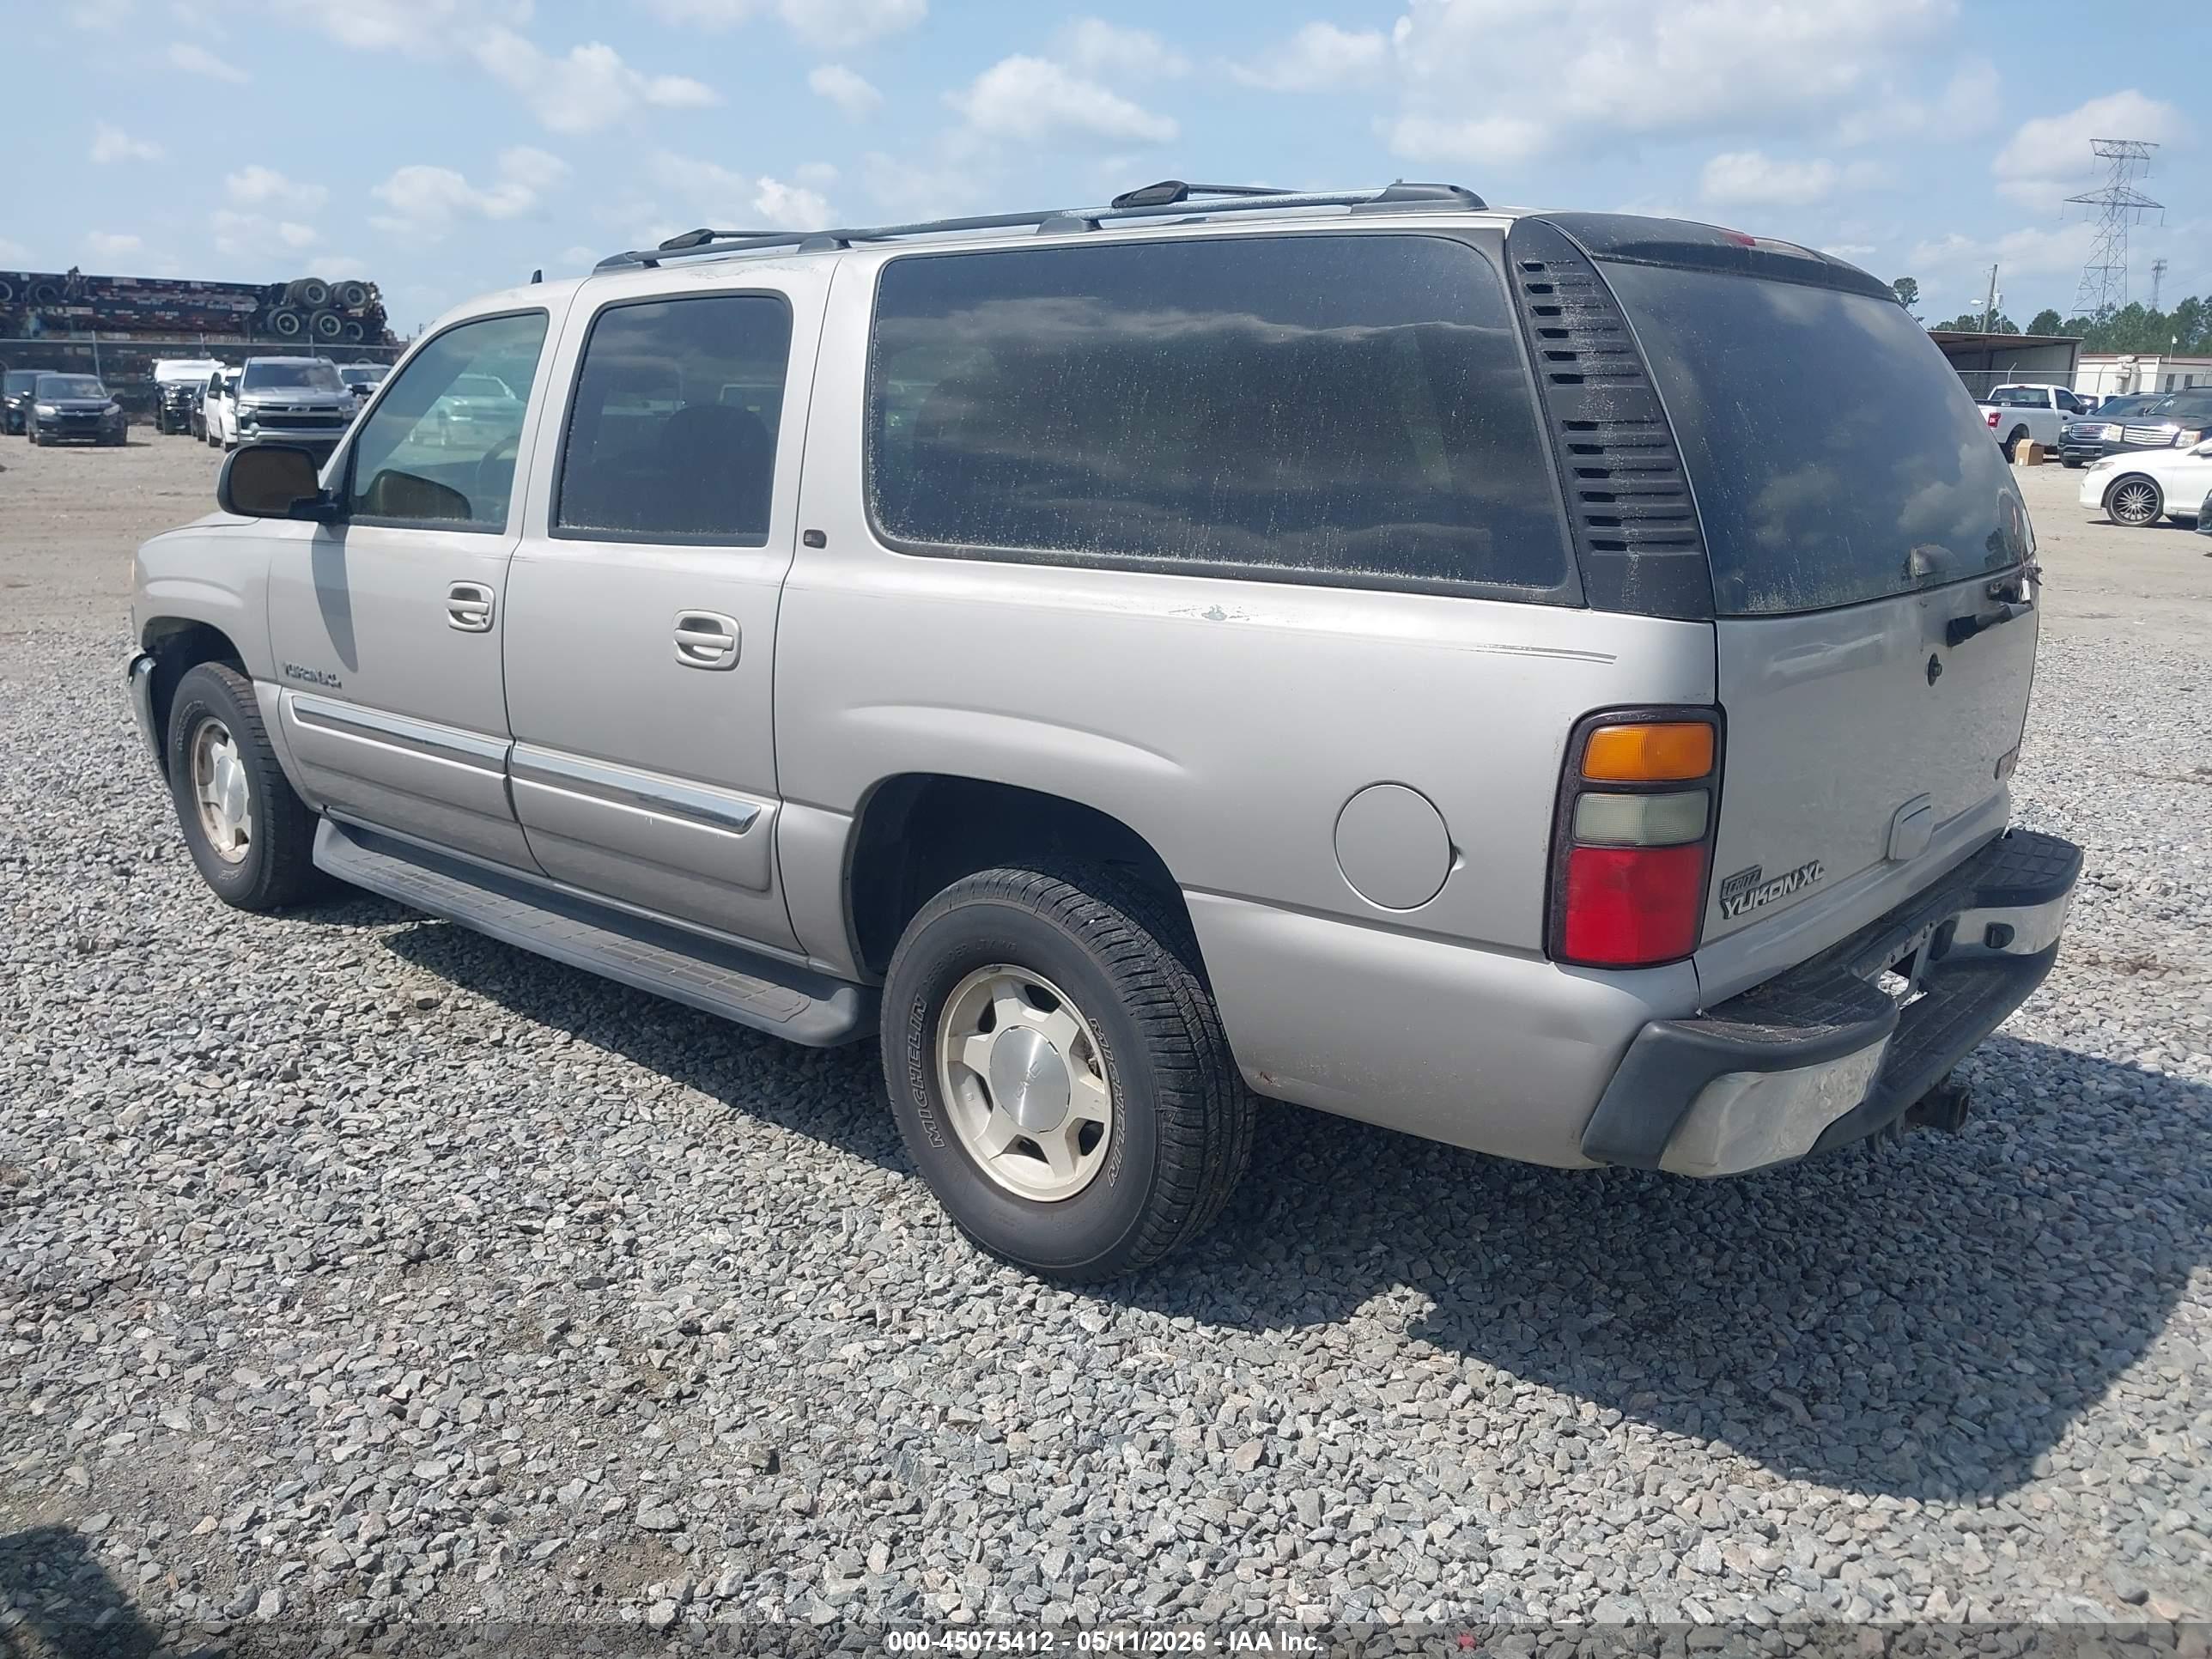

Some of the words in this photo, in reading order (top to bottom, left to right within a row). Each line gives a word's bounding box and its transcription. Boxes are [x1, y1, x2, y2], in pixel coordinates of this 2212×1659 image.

[1721, 872, 1799, 920] YUKON
[1798, 860, 1825, 888] XL
[908, 994, 945, 1148] MICHELIN
[1088, 1018, 1126, 1188] MICHELIN
